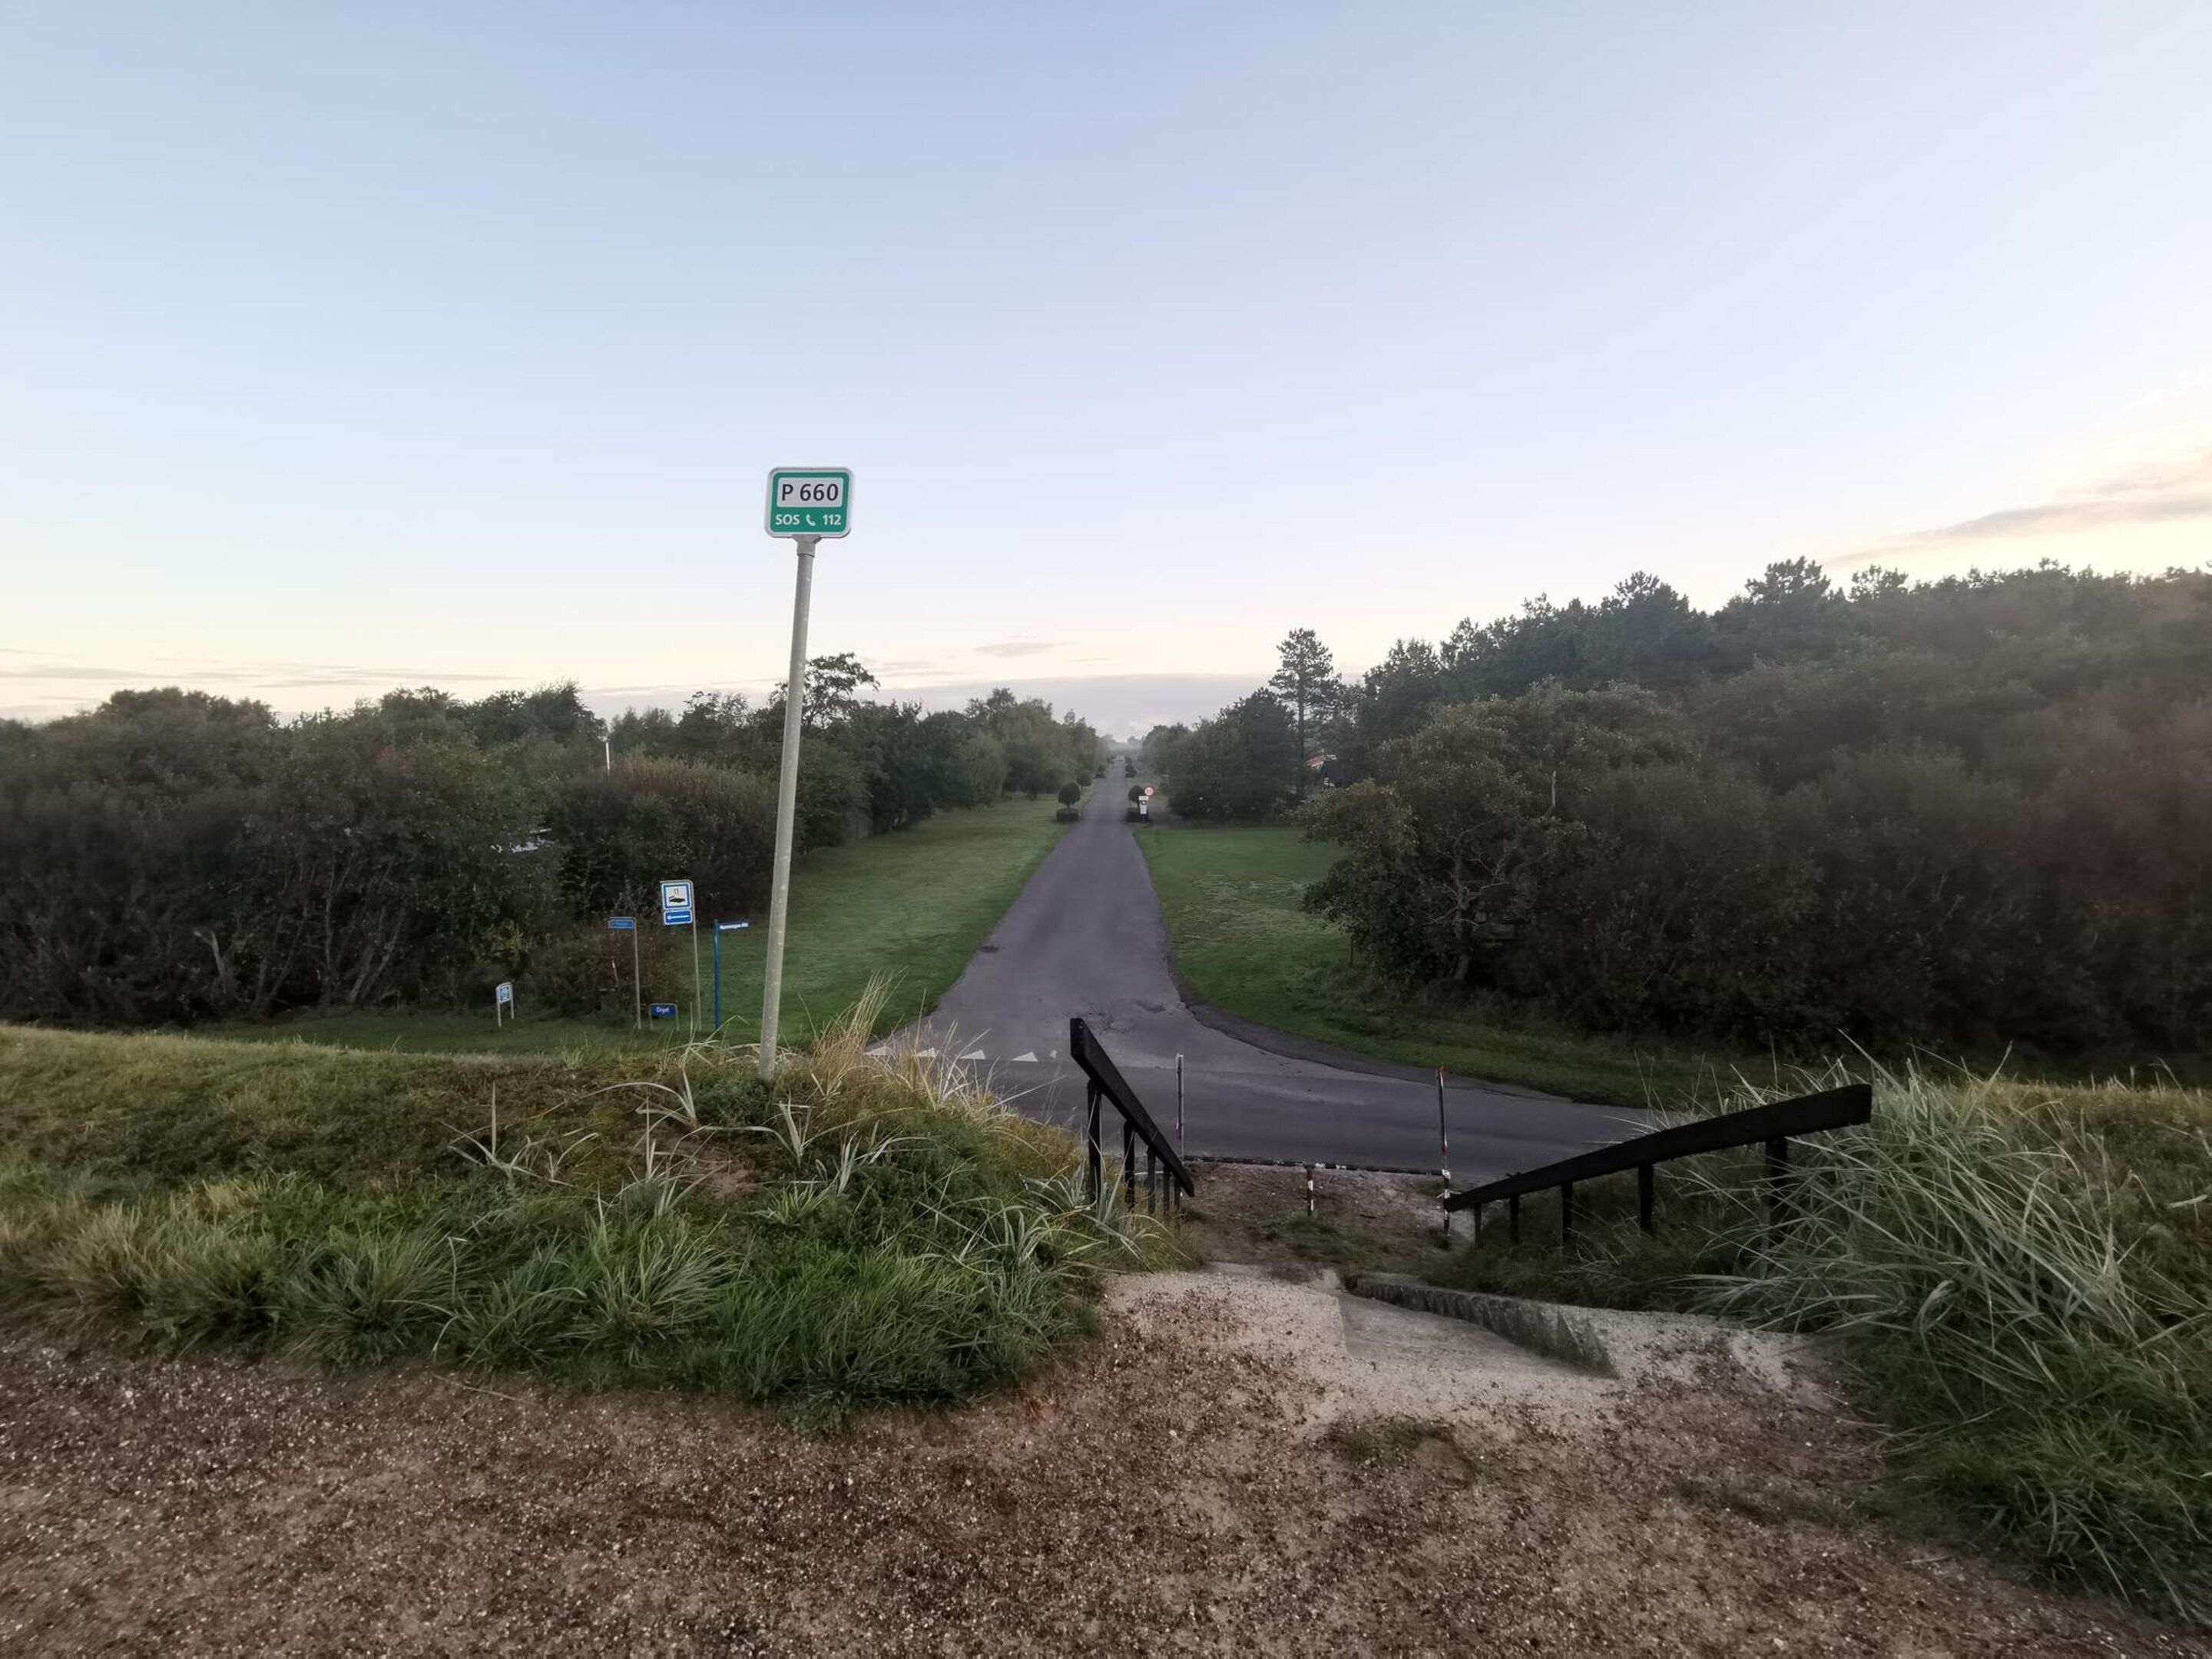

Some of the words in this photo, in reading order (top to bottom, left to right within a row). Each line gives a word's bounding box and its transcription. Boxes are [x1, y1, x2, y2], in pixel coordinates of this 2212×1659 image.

[782, 484, 793, 501] P
[800, 484, 839, 502] 660
[776, 515, 800, 525] SOS
[823, 515, 842, 525] 112
